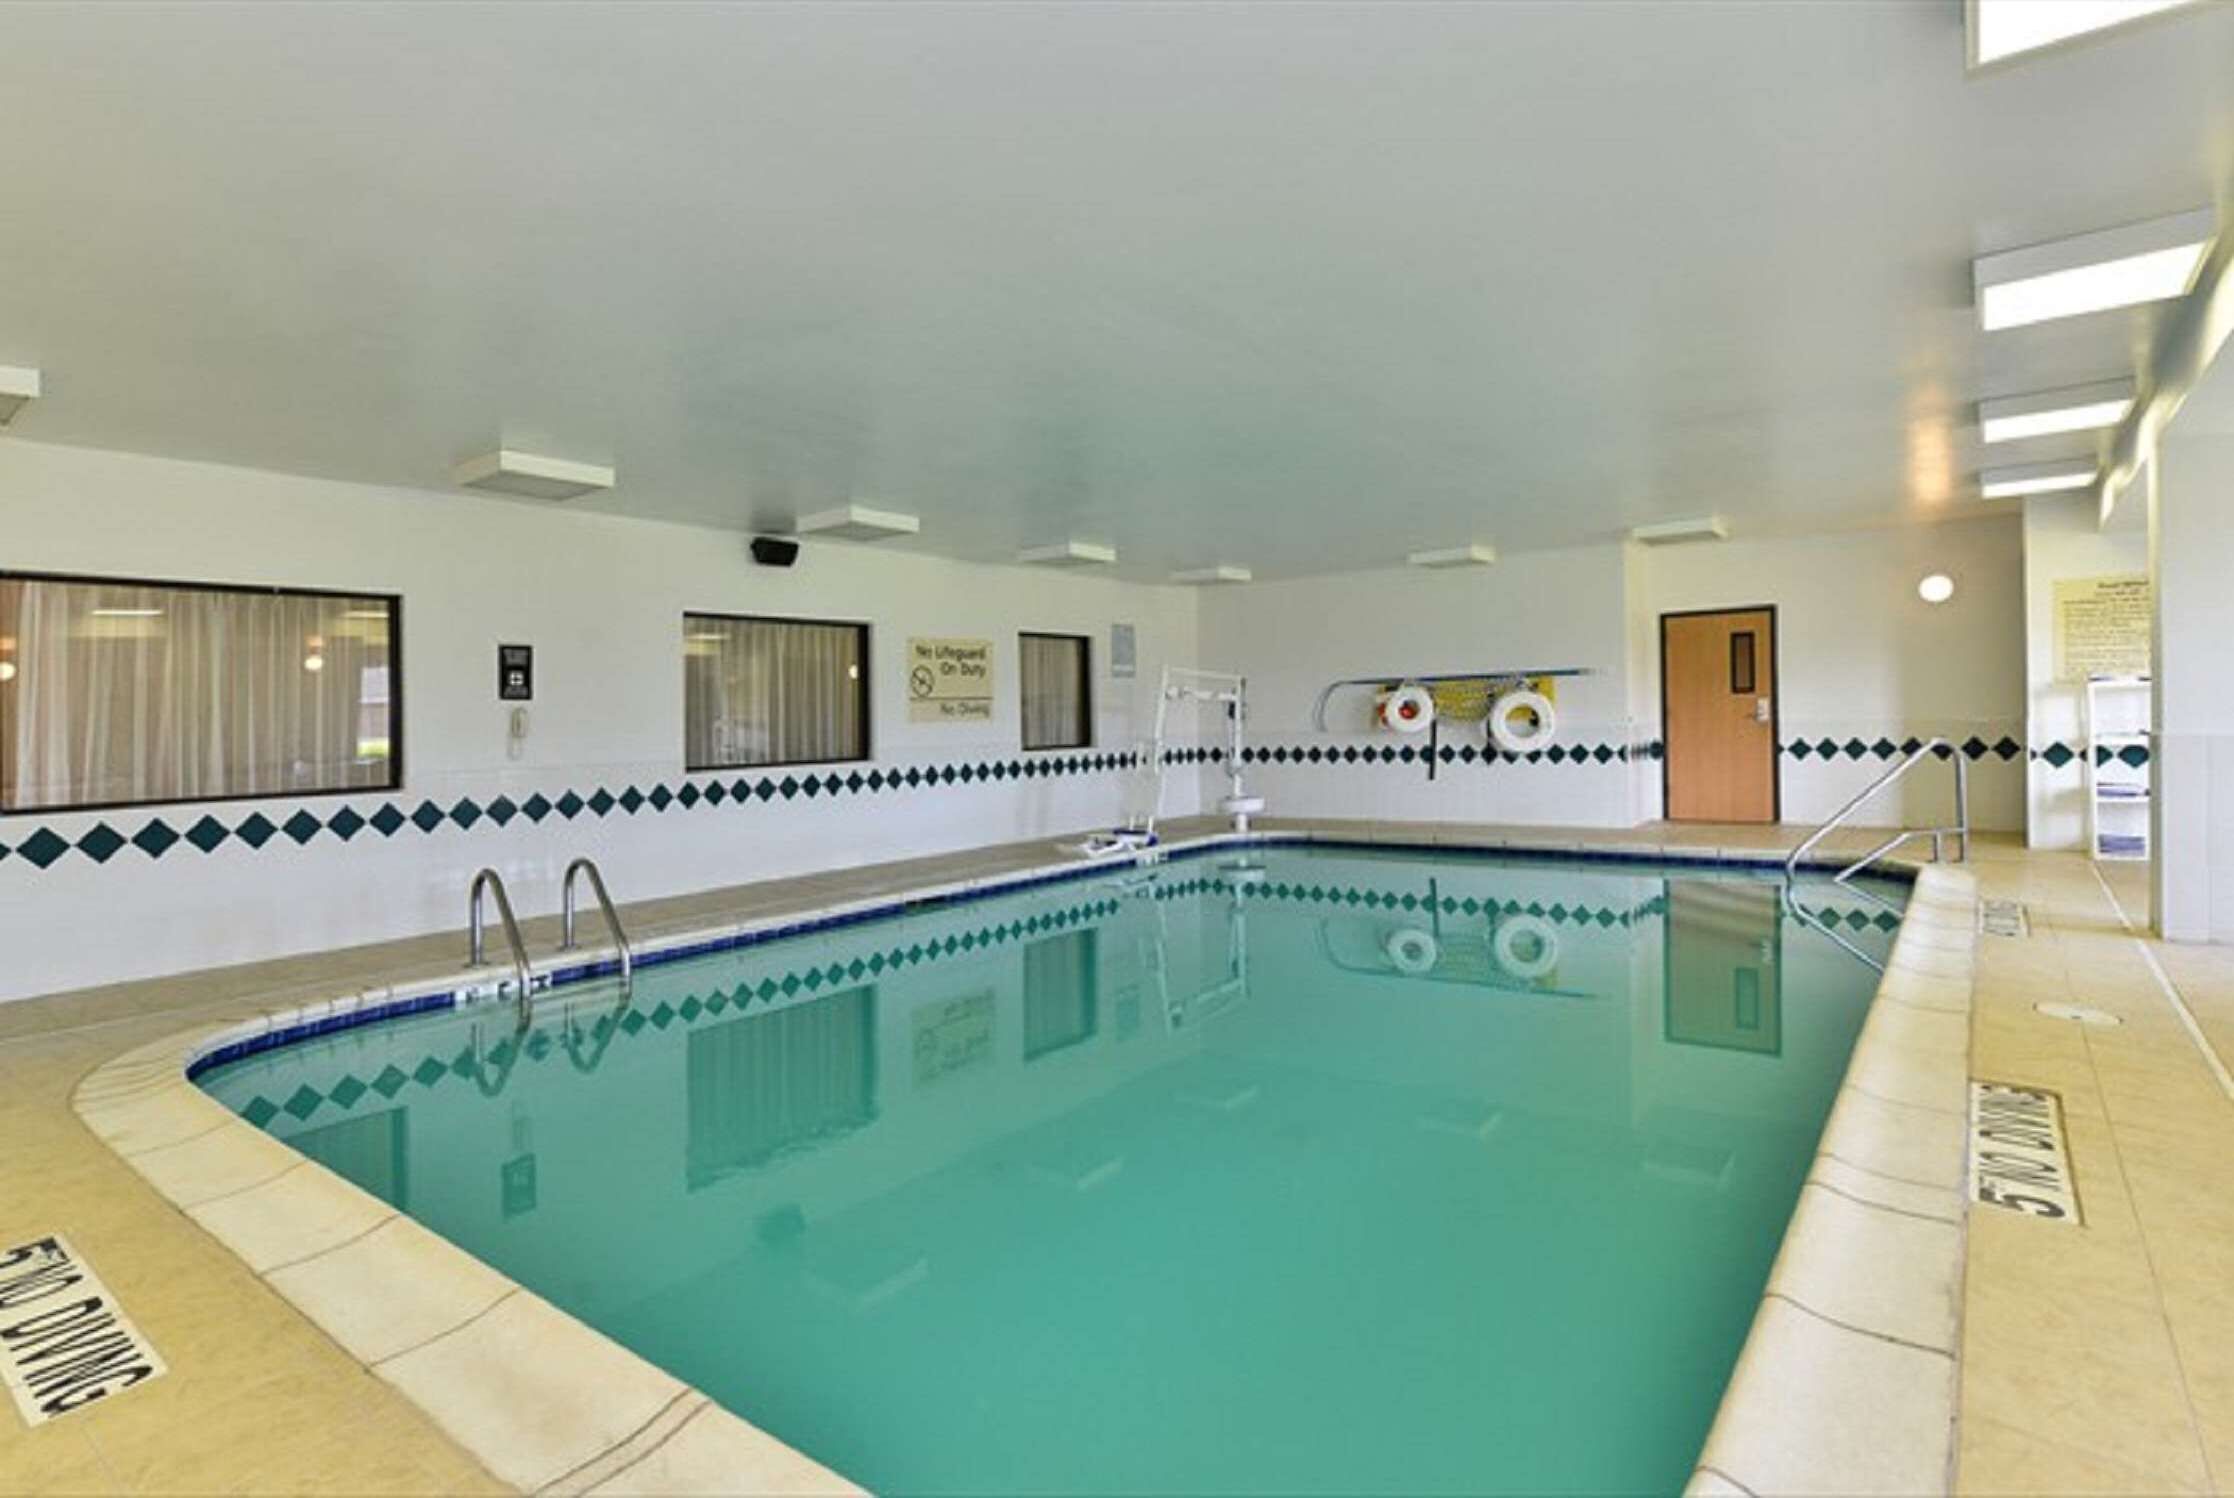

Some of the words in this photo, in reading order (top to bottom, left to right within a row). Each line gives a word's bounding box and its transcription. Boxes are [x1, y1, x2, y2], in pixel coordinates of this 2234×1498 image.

[915, 645, 932, 659] No
[935, 645, 986, 662] Lifeguard
[940, 661, 957, 676] On
[961, 661, 986, 679] Duty
[0, 1297, 153, 1418] DIVING
